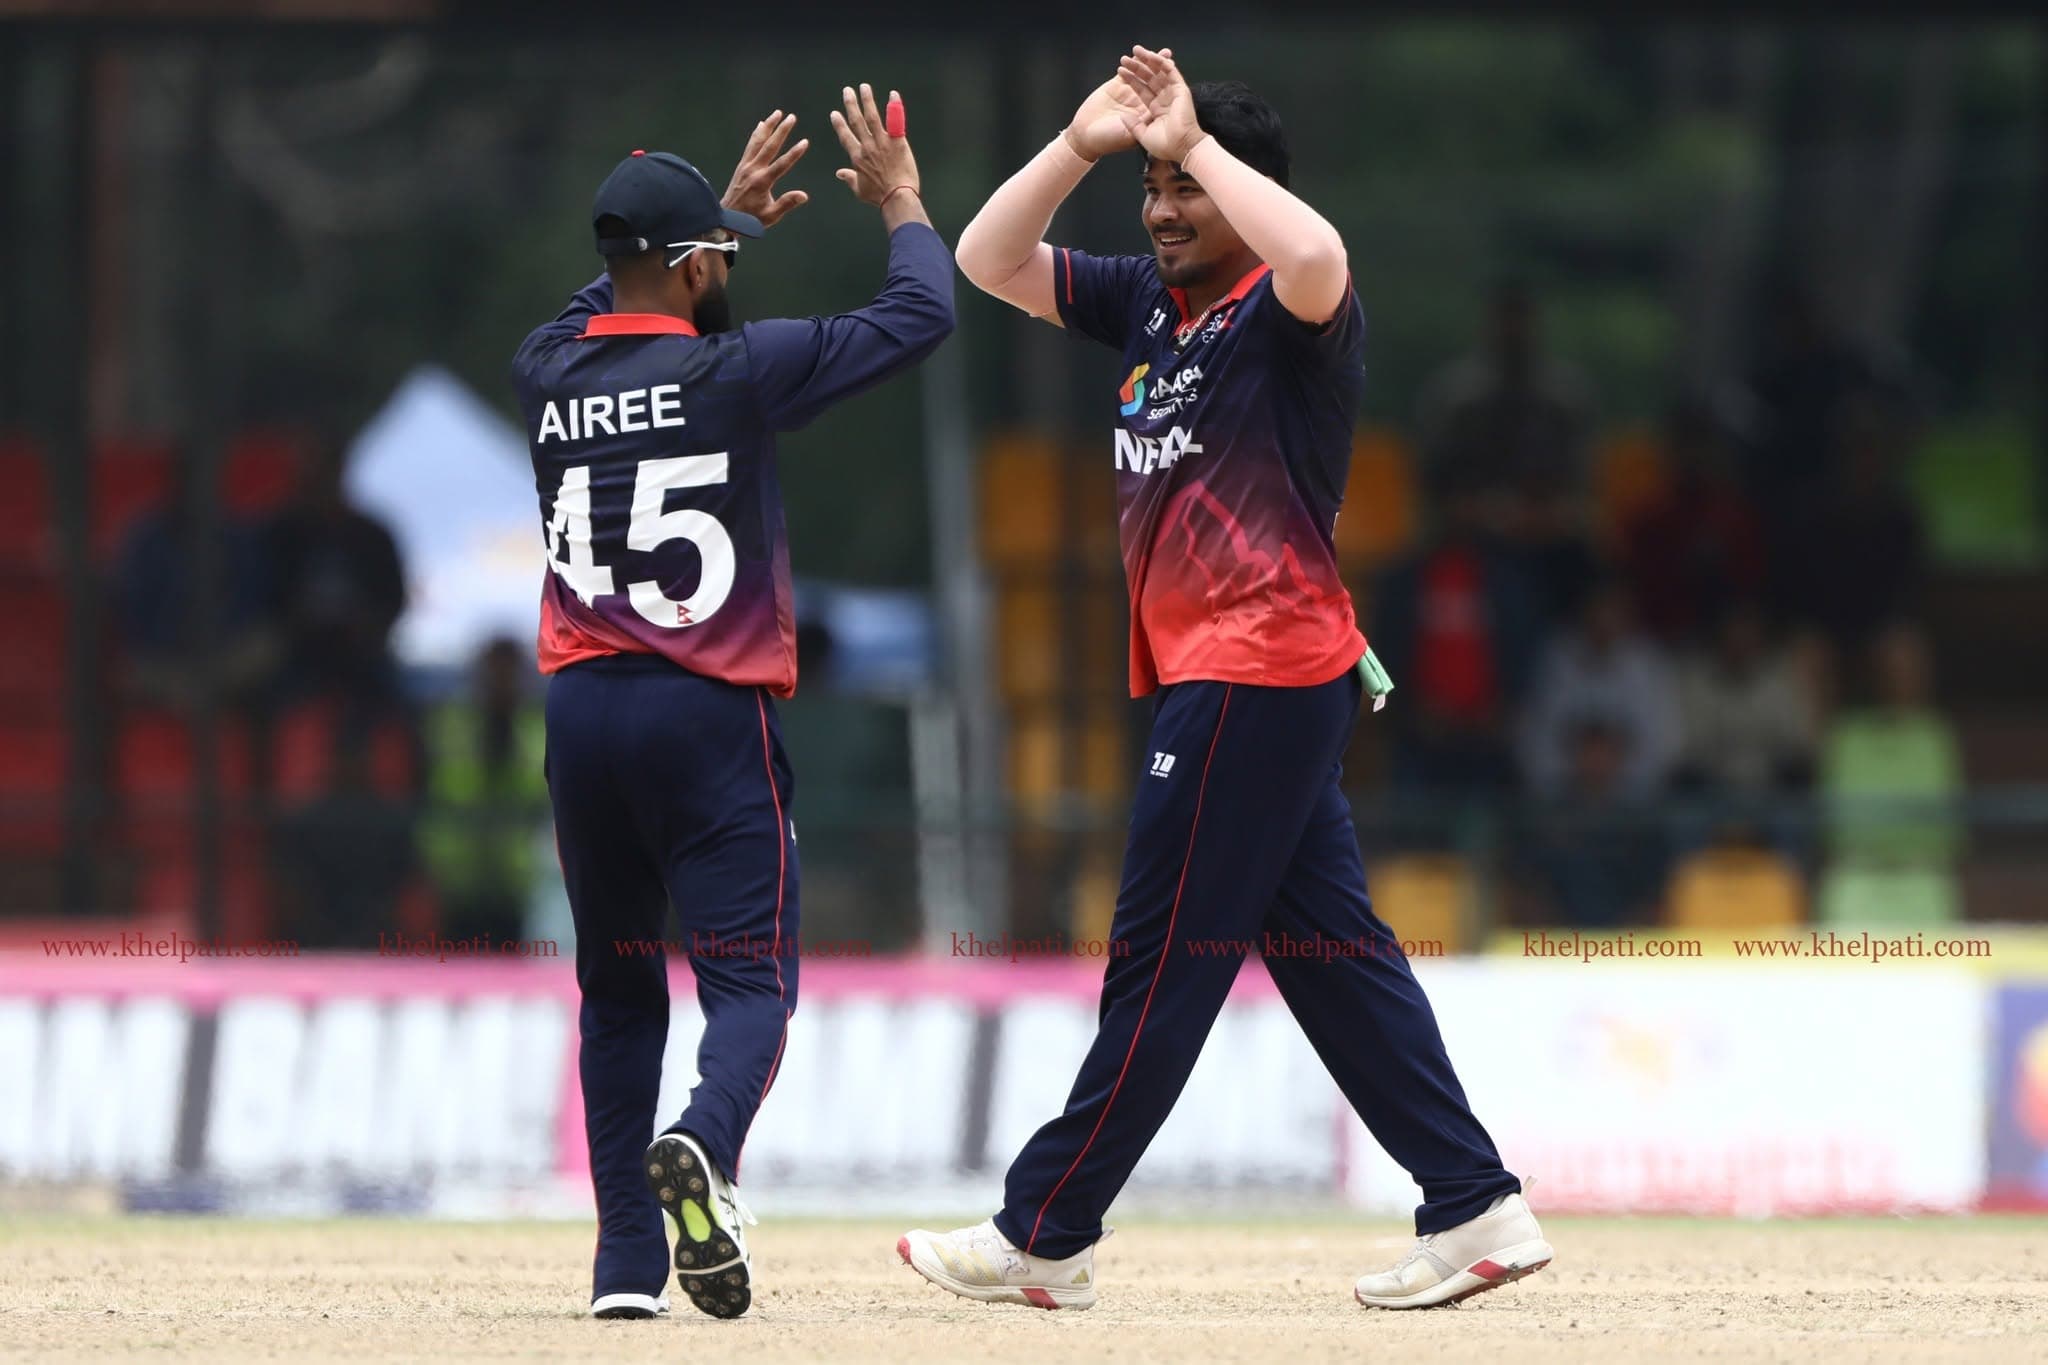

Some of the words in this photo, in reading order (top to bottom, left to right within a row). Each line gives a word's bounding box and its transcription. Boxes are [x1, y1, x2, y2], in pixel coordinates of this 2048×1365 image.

[538, 384, 685, 443] AIREE
[1114, 426, 1204, 474] NEAL
[545, 452, 736, 628] 45
